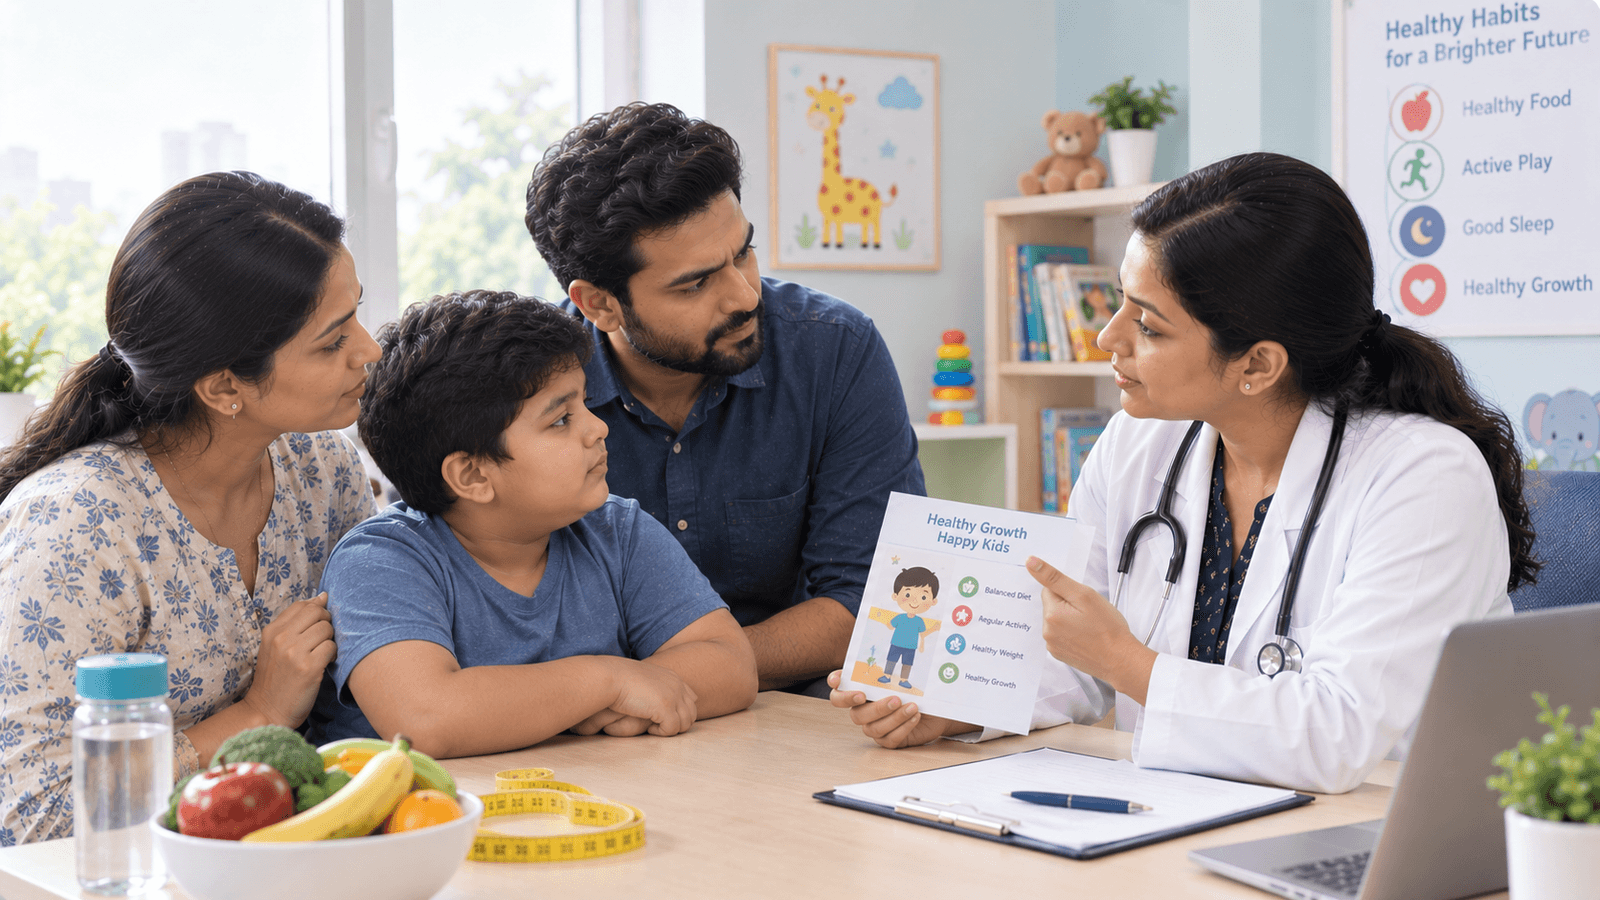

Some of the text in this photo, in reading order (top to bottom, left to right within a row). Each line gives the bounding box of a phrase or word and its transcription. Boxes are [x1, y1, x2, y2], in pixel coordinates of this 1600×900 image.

[1386, 3, 1540, 40] Healthy Habits
[1385, 27, 1590, 68] for a Brighter Future
[1462, 90, 1572, 117] Healthy Food
[1462, 153, 1552, 176] Active Play
[1462, 215, 1554, 236] Good Sleep
[1464, 274, 1593, 298] Healthy Growth
[927, 513, 1027, 540] Healthy Growth
[937, 531, 1010, 553] Happy Kids
[984, 586, 1032, 601] Balanced Diet
[1005, 620, 1031, 632] Activity
[972, 644, 1024, 660] Healthy Weight
[965, 673, 1016, 689] Healthy Growth
